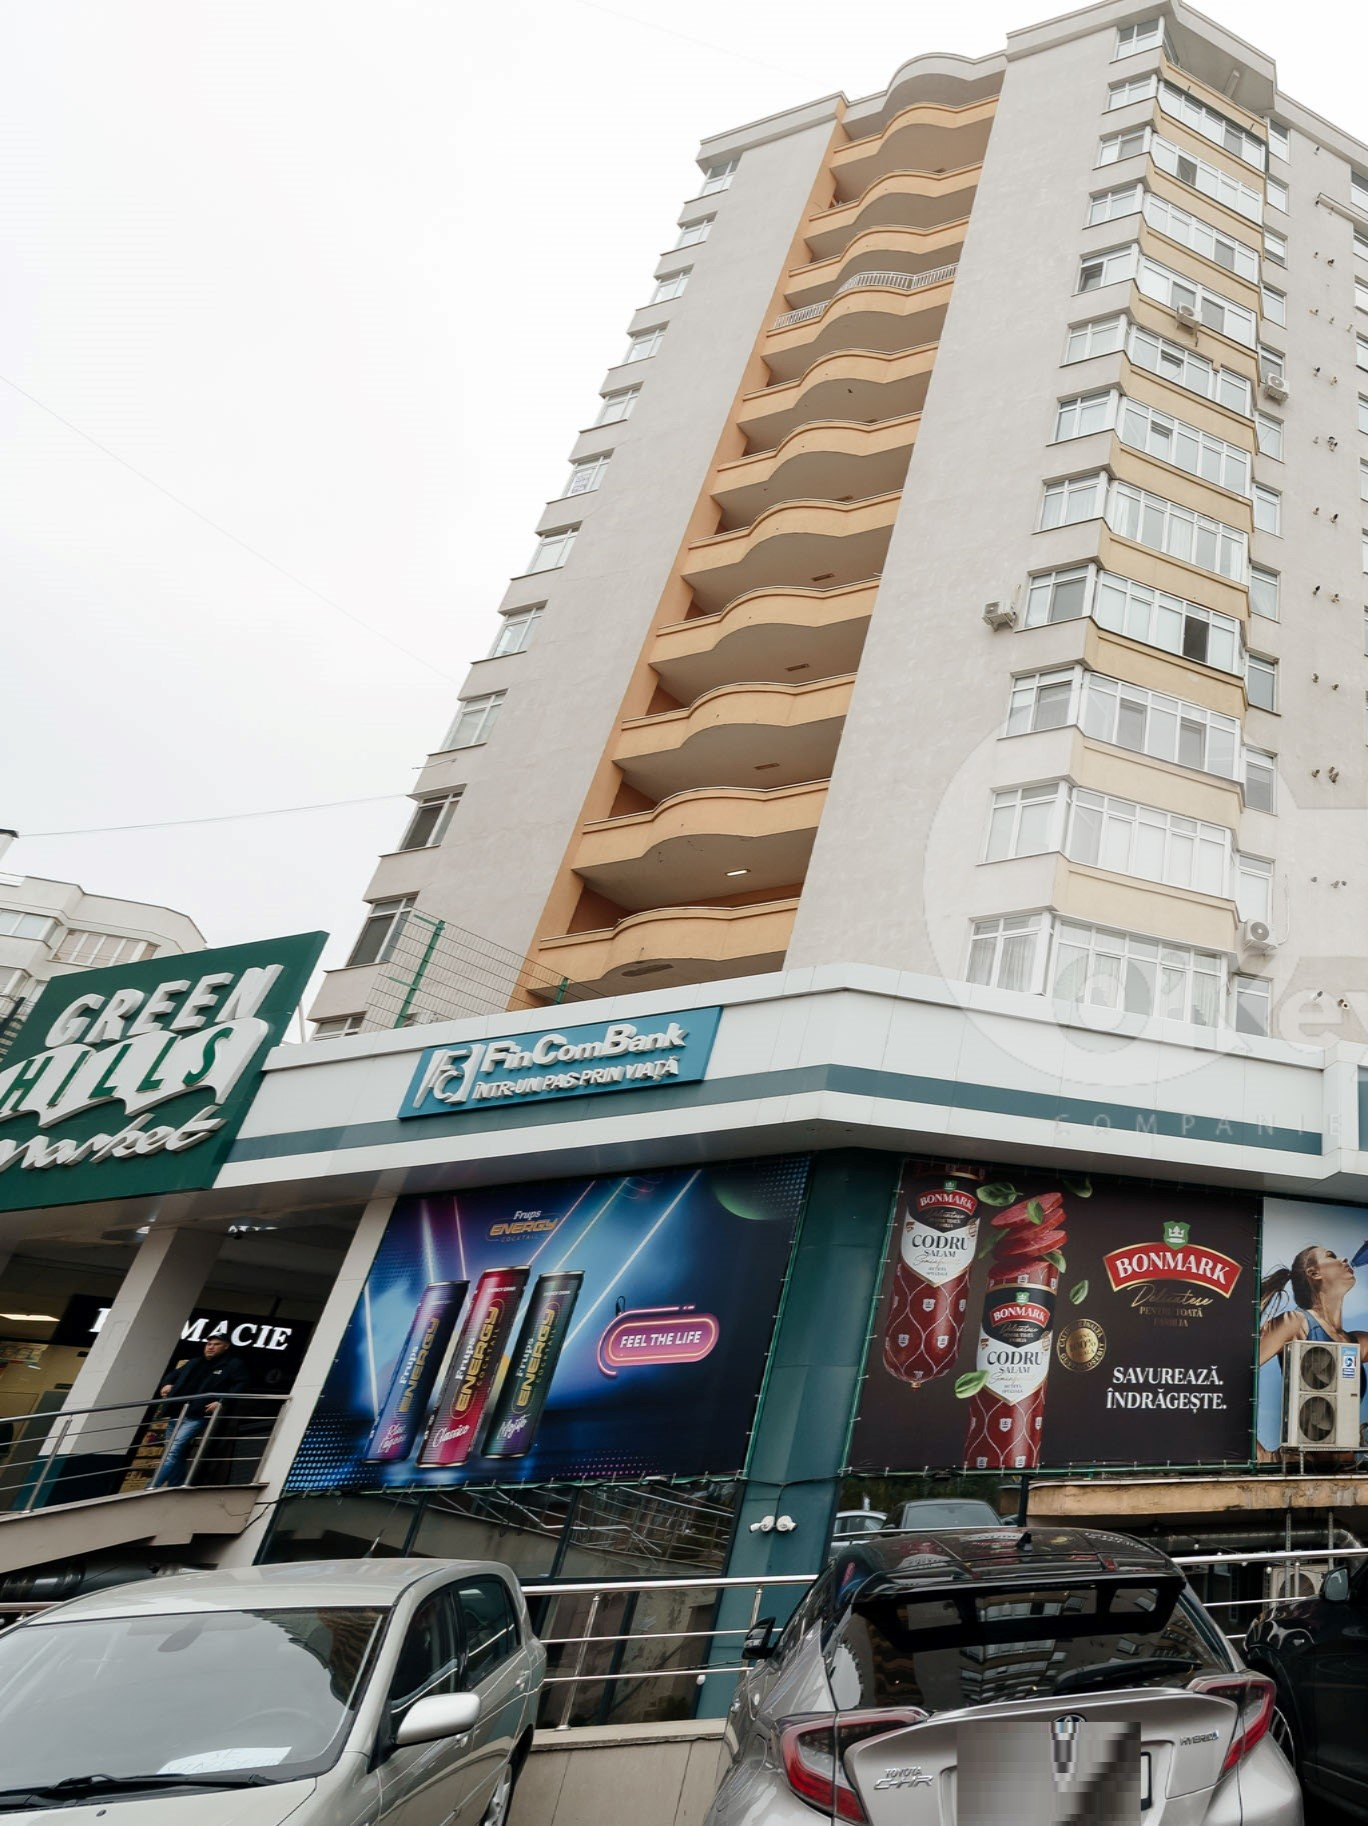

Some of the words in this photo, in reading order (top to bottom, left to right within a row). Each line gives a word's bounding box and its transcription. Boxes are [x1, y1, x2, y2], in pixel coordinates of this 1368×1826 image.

[45, 964, 284, 1047] GREEN
[479, 1022, 690, 1073] FinComBank
[0, 1027, 235, 1113] HILLS
[542, 1071, 581, 1090] PAS
[580, 1066, 623, 1084] PRIN
[920, 1193, 974, 1209] BONMARK
[513, 1210, 543, 1220] Frups
[489, 1217, 560, 1237] ENERGY
[911, 1234, 968, 1251] CODRU
[1115, 1251, 1230, 1285] BONMARK
[993, 1306, 1047, 1322] BONMARK
[620, 1333, 647, 1348] FEEL
[650, 1332, 674, 1346] THE
[675, 1331, 703, 1344] LIFE
[455, 1337, 476, 1380] Frups
[455, 1306, 499, 1412] ENERGY
[516, 1308, 556, 1407] ENERGY
[986, 1350, 1043, 1366] CODRU
[1112, 1365, 1224, 1386] SAVUREAZĂ.
[1106, 1387, 1228, 1414] ÎNDRĂGEȘTE.
[885, 1766, 922, 1778] TOYOTA
